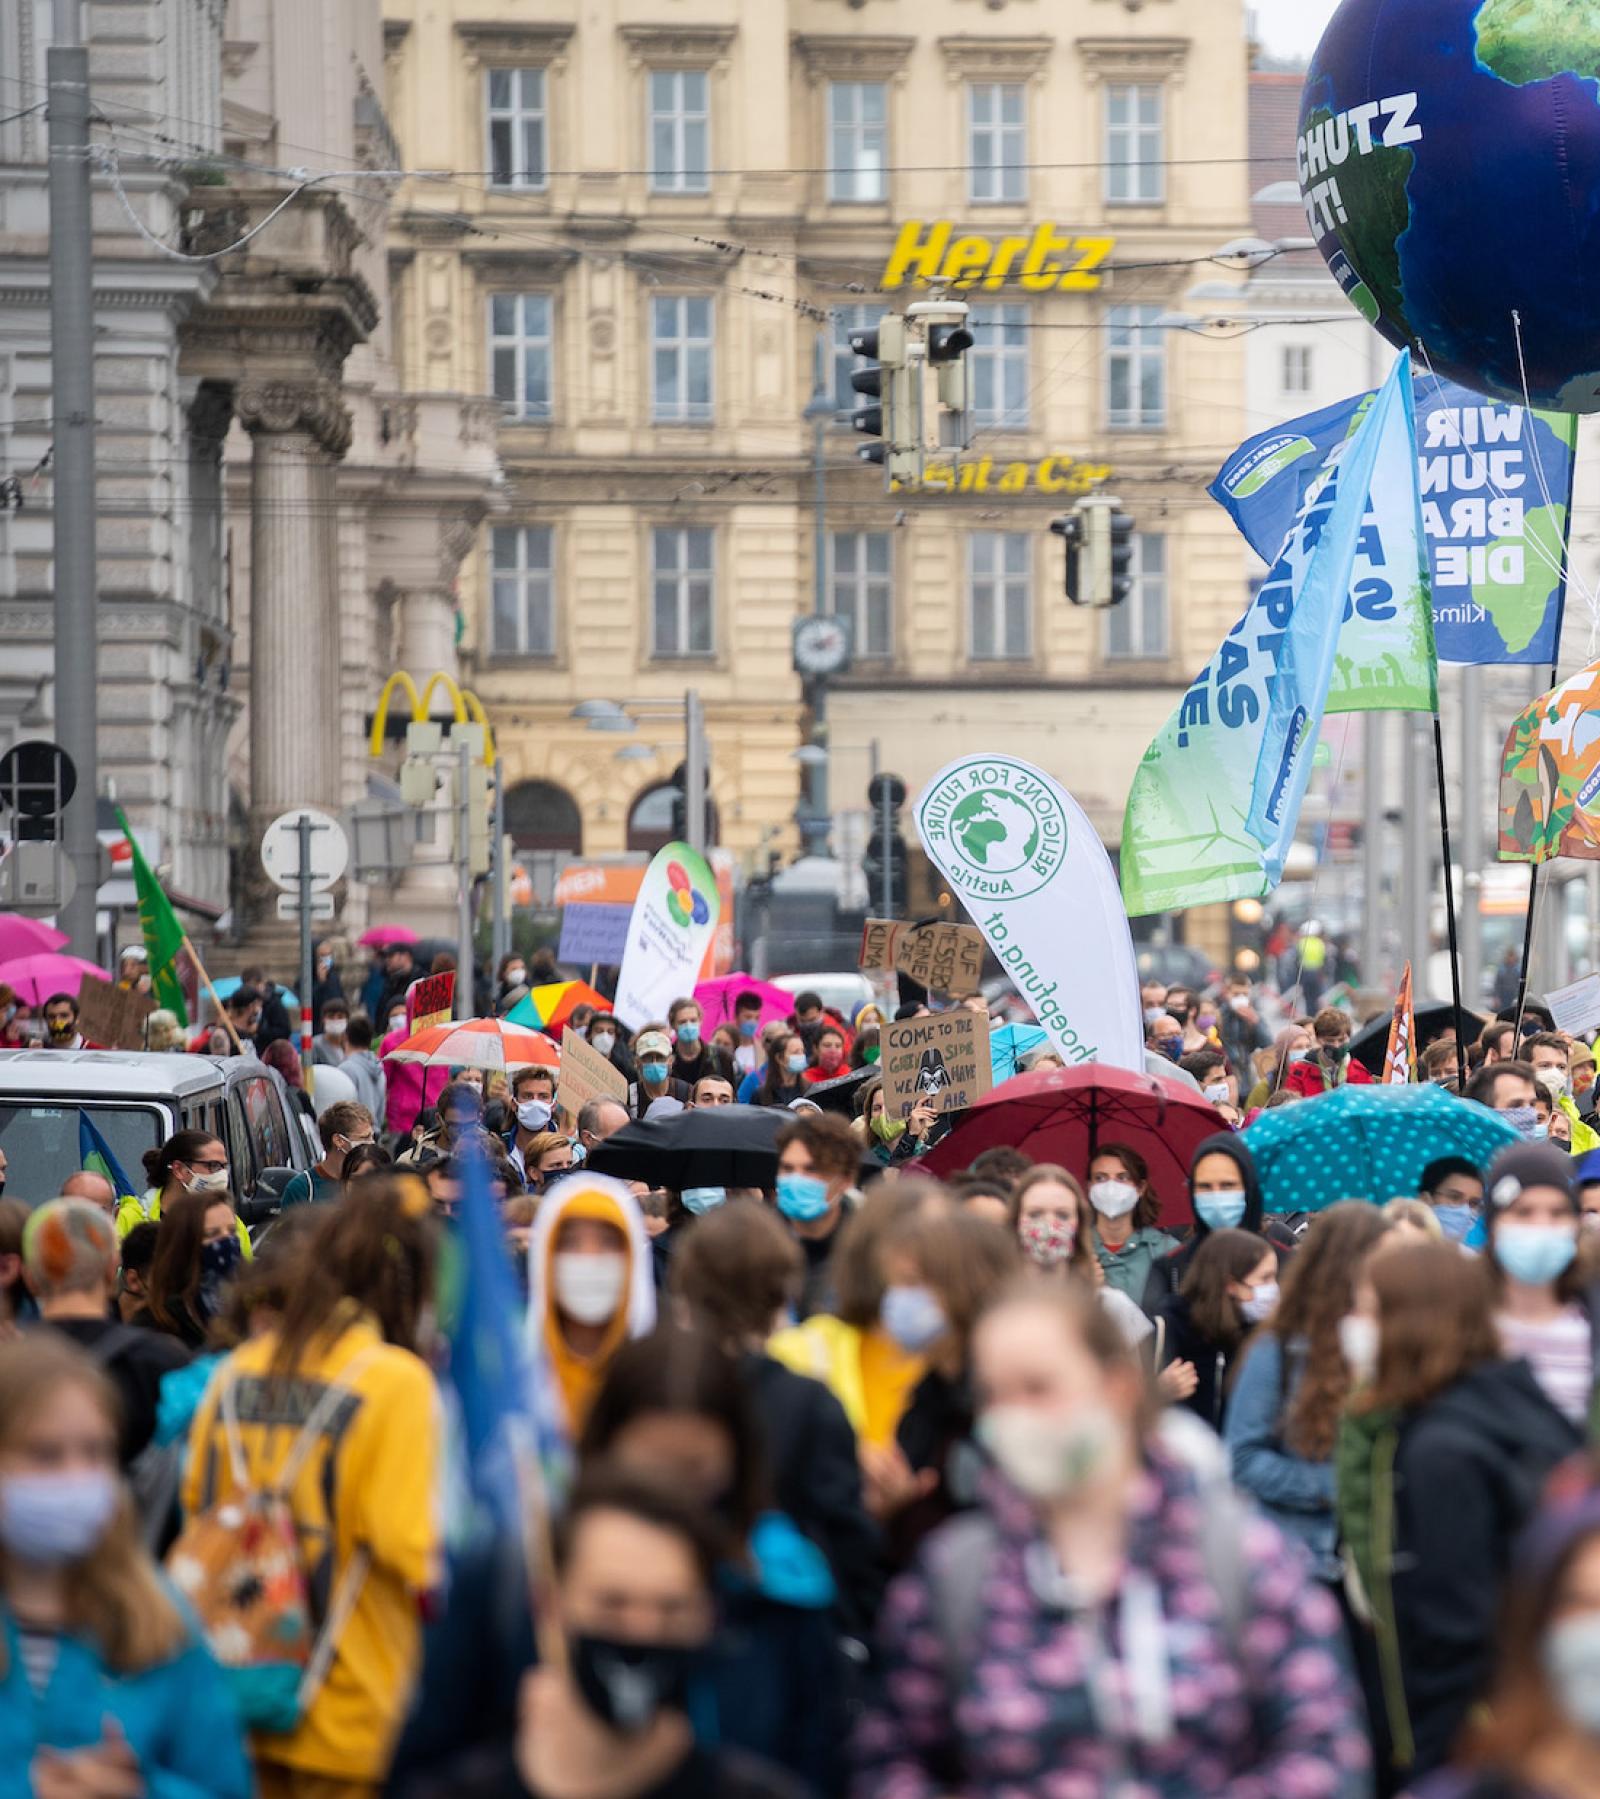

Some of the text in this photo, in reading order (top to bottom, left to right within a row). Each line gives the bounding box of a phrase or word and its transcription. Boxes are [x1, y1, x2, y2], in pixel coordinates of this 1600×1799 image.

[880, 220, 1116, 291] Hertz
[998, 462, 1029, 493] a
[864, 924, 889, 970] KLIMA
[960, 936, 979, 976] AUF
[889, 1018, 972, 1048] COME TO THE
[894, 1078, 913, 1094] WE
[943, 1091, 968, 1109] AIR
